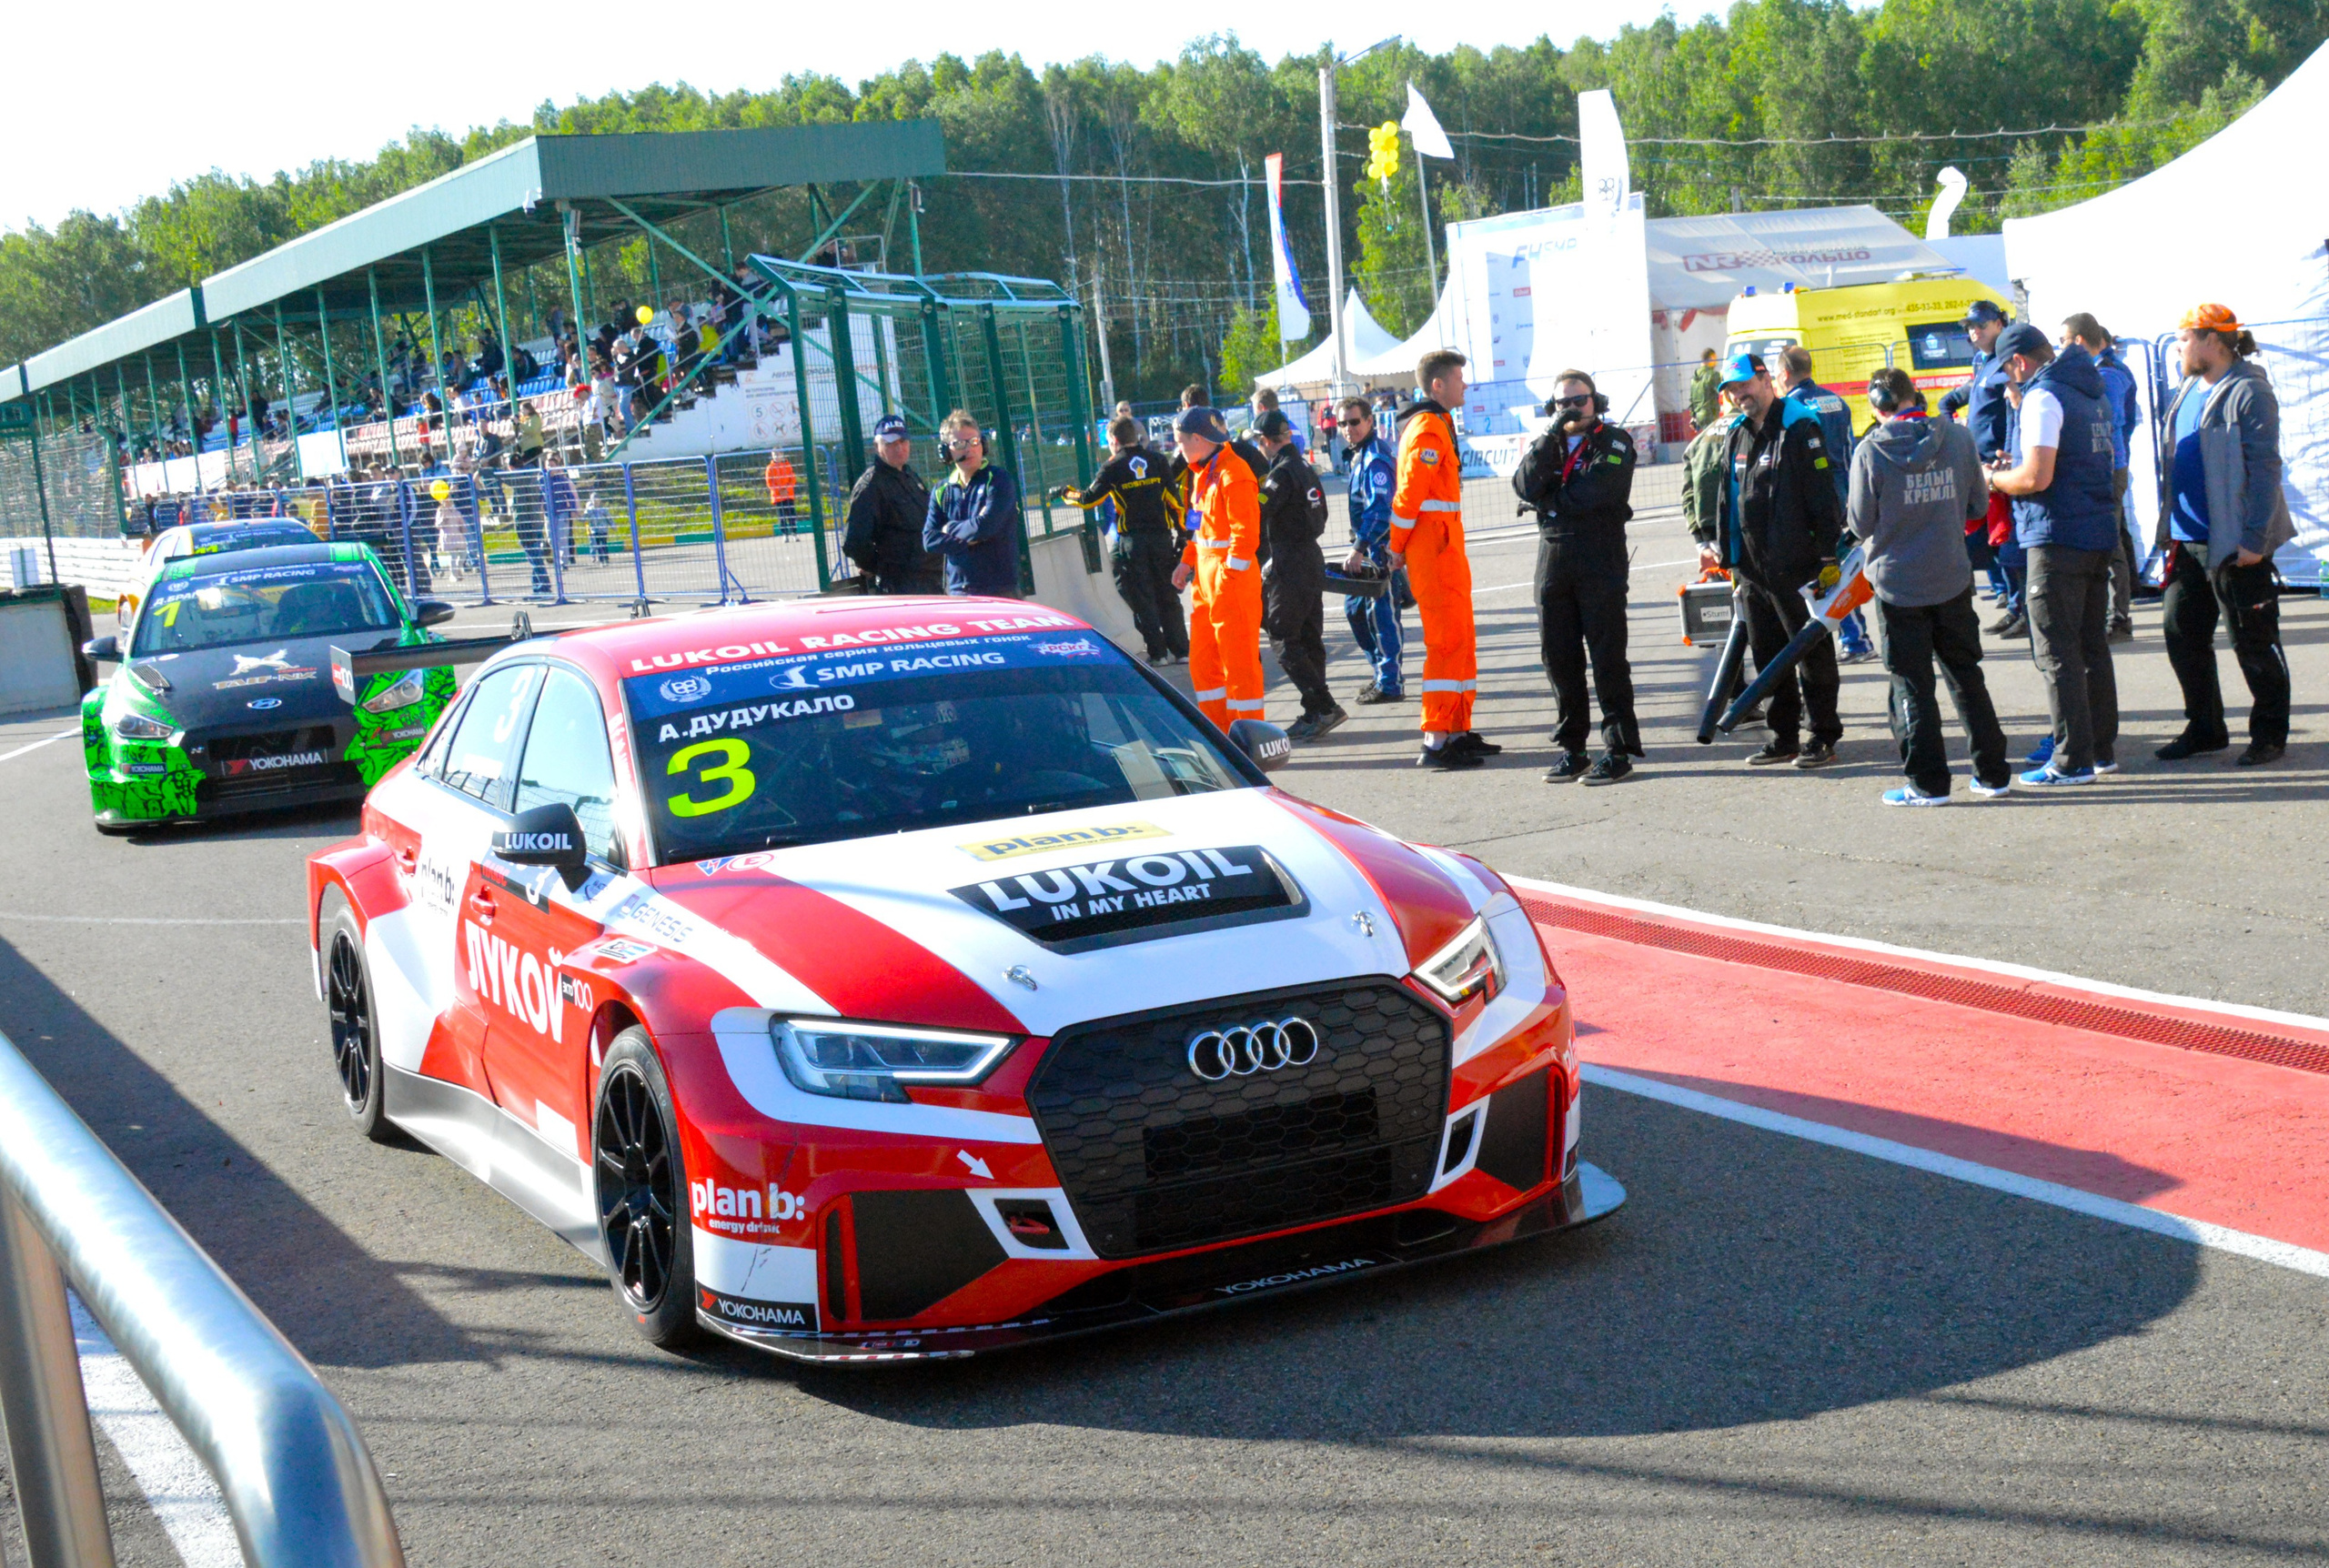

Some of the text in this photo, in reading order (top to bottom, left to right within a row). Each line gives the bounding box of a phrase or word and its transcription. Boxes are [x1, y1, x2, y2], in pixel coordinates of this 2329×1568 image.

[756, 407, 763, 418] 5
[1485, 417, 1492, 433] 2
[1461, 448, 1517, 467] CIRCUIT
[1905, 467, 1954, 489] БЕЛЫЙ
[1903, 485, 1957, 505] КРЕМЛЬ
[230, 569, 316, 583] SMP RACING
[153, 600, 181, 628] 1
[630, 616, 1075, 672] LUKOIL RACING TEAM
[706, 634, 1033, 675] Российская серия кольцевых гонок
[212, 671, 318, 690] TAIF-NK
[815, 652, 1005, 682] SMP RACING
[493, 667, 536, 744] 3
[658, 694, 856, 743] А.ДУДУКАЛО
[392, 729, 426, 739] YOKOHAMA
[130, 765, 166, 775] YOKOHAMA
[248, 751, 324, 772] YOKOHAMA
[666, 737, 756, 818] 3
[505, 831, 573, 850] LUKOIL
[983, 829, 1095, 856] plan
[978, 848, 1254, 911] LUKOIL
[1050, 882, 1212, 922] IN MY HEART
[630, 901, 694, 943] GENESIS
[691, 1177, 805, 1221] plan b:
[709, 1218, 781, 1234] energy drink
[1214, 1257, 1376, 1296] YOKOHAMA
[717, 1297, 805, 1325] YOKOHAMA
